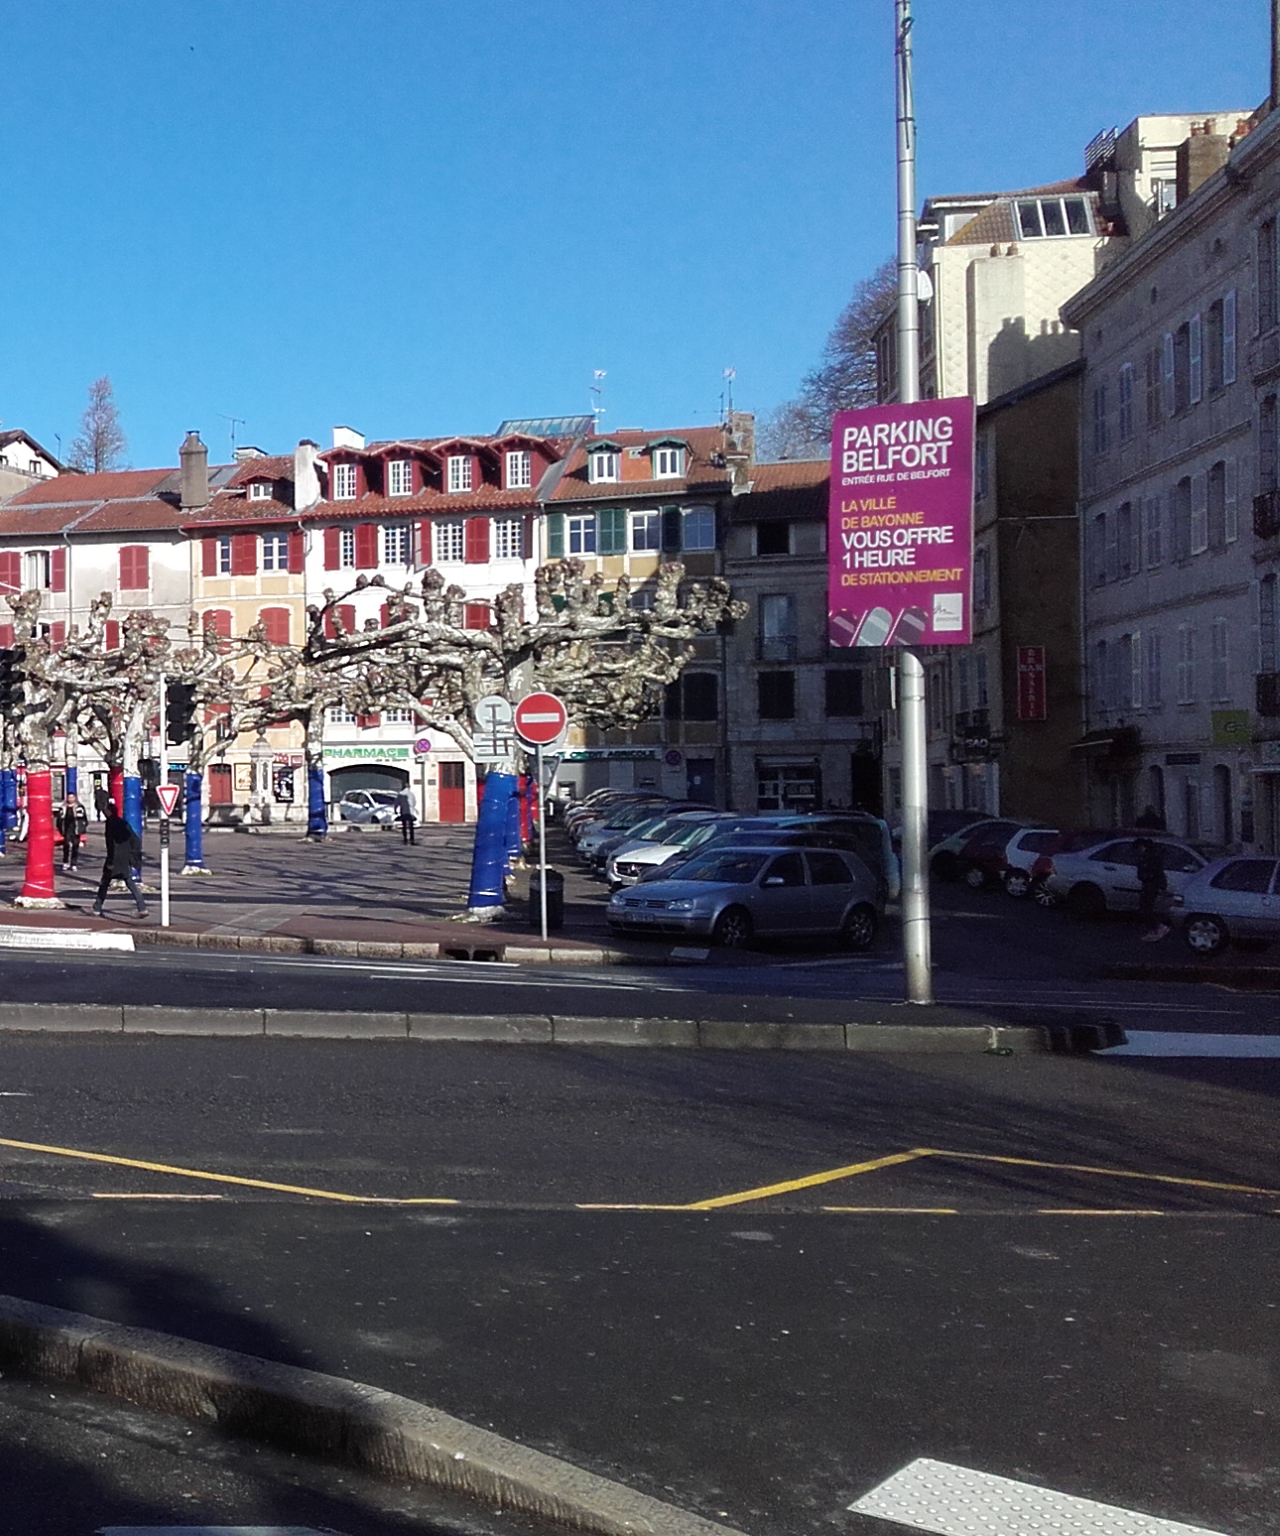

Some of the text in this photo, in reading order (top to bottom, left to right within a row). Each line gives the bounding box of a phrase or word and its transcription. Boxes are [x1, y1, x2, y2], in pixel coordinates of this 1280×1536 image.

[843, 417, 953, 449] PARKING
[842, 441, 953, 473] BELFORT
[841, 468, 951, 486] ENTRÉE RUE DE BELFORT
[841, 497, 897, 513] LA VILLE
[841, 512, 925, 529] DE BAYONNE
[841, 526, 954, 549] VOUS OFFRE
[842, 548, 915, 569] 1 HEURE
[841, 568, 963, 586] DE STATIONNEMENT
[323, 747, 409, 758] PHARMACIE
